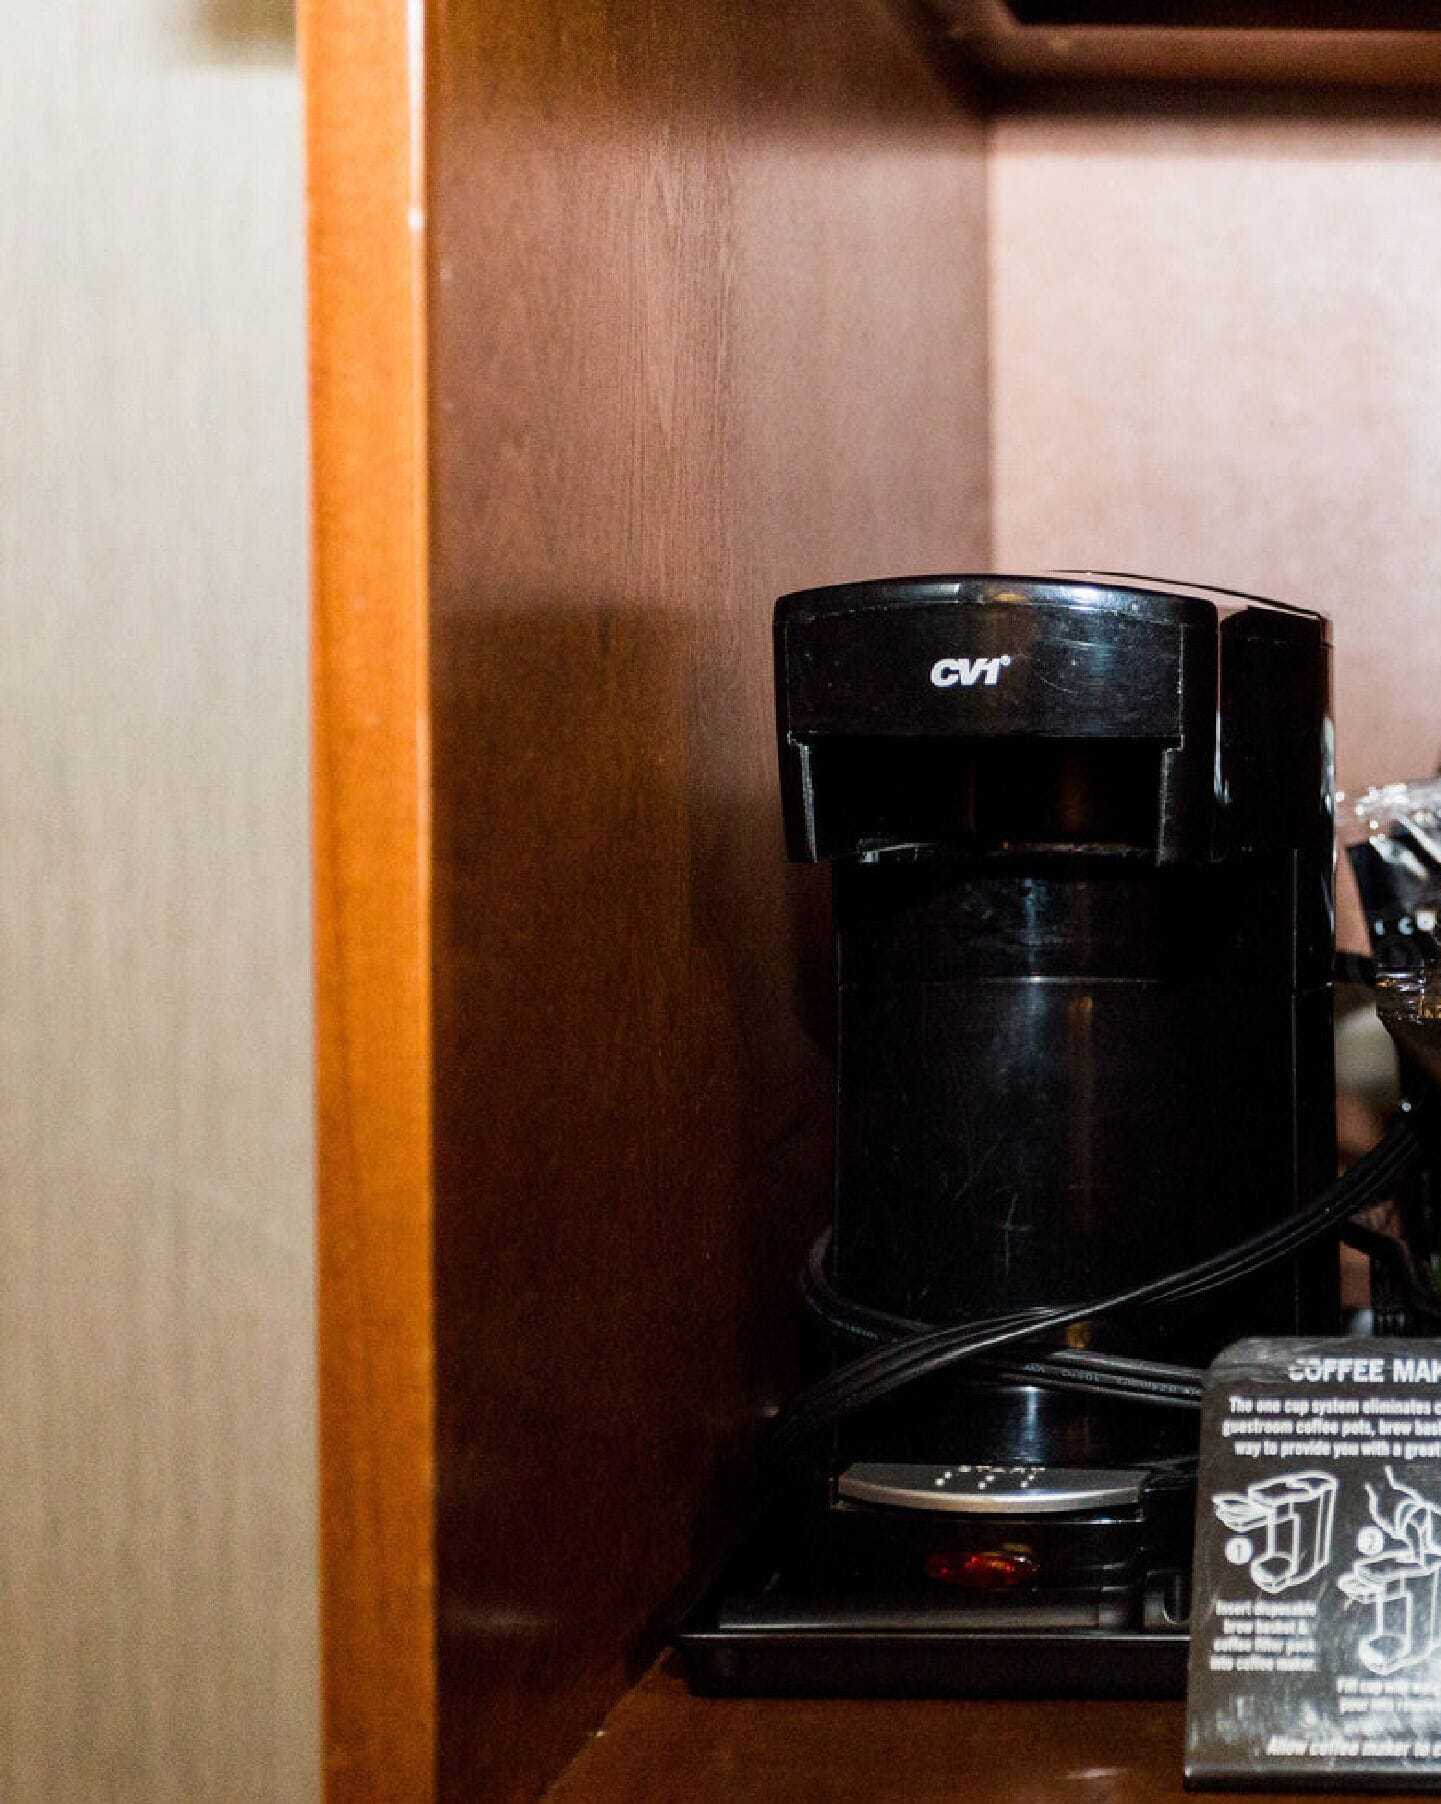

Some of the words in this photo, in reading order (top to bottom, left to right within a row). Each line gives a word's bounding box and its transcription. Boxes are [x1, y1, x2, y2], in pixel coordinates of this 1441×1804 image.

[1288, 1358, 1385, 1383] COFFEE
[1229, 1395, 1252, 1414] The
[1256, 1400, 1281, 1414] one
[1284, 1400, 1309, 1417] cup
[1312, 1398, 1360, 1417] system
[1362, 1397, 1431, 1416] eliminates
[1222, 1419, 1293, 1438] guestroom
[1296, 1418, 1338, 1436] coffee
[1342, 1420, 1376, 1438] pots,
[1379, 1419, 1412, 1437] brew
[1234, 1442, 1261, 1459] way
[1264, 1441, 1278, 1456] to
[1281, 1441, 1331, 1459] provide
[1333, 1442, 1359, 1460] you
[1361, 1441, 1390, 1457] with
[1393, 1443, 1401, 1458] a
[1403, 1442, 1441, 1460] great
[1308, 1737, 1360, 1757] coffee
[1362, 1737, 1411, 1757] maker
[1414, 1738, 1429, 1758] to
